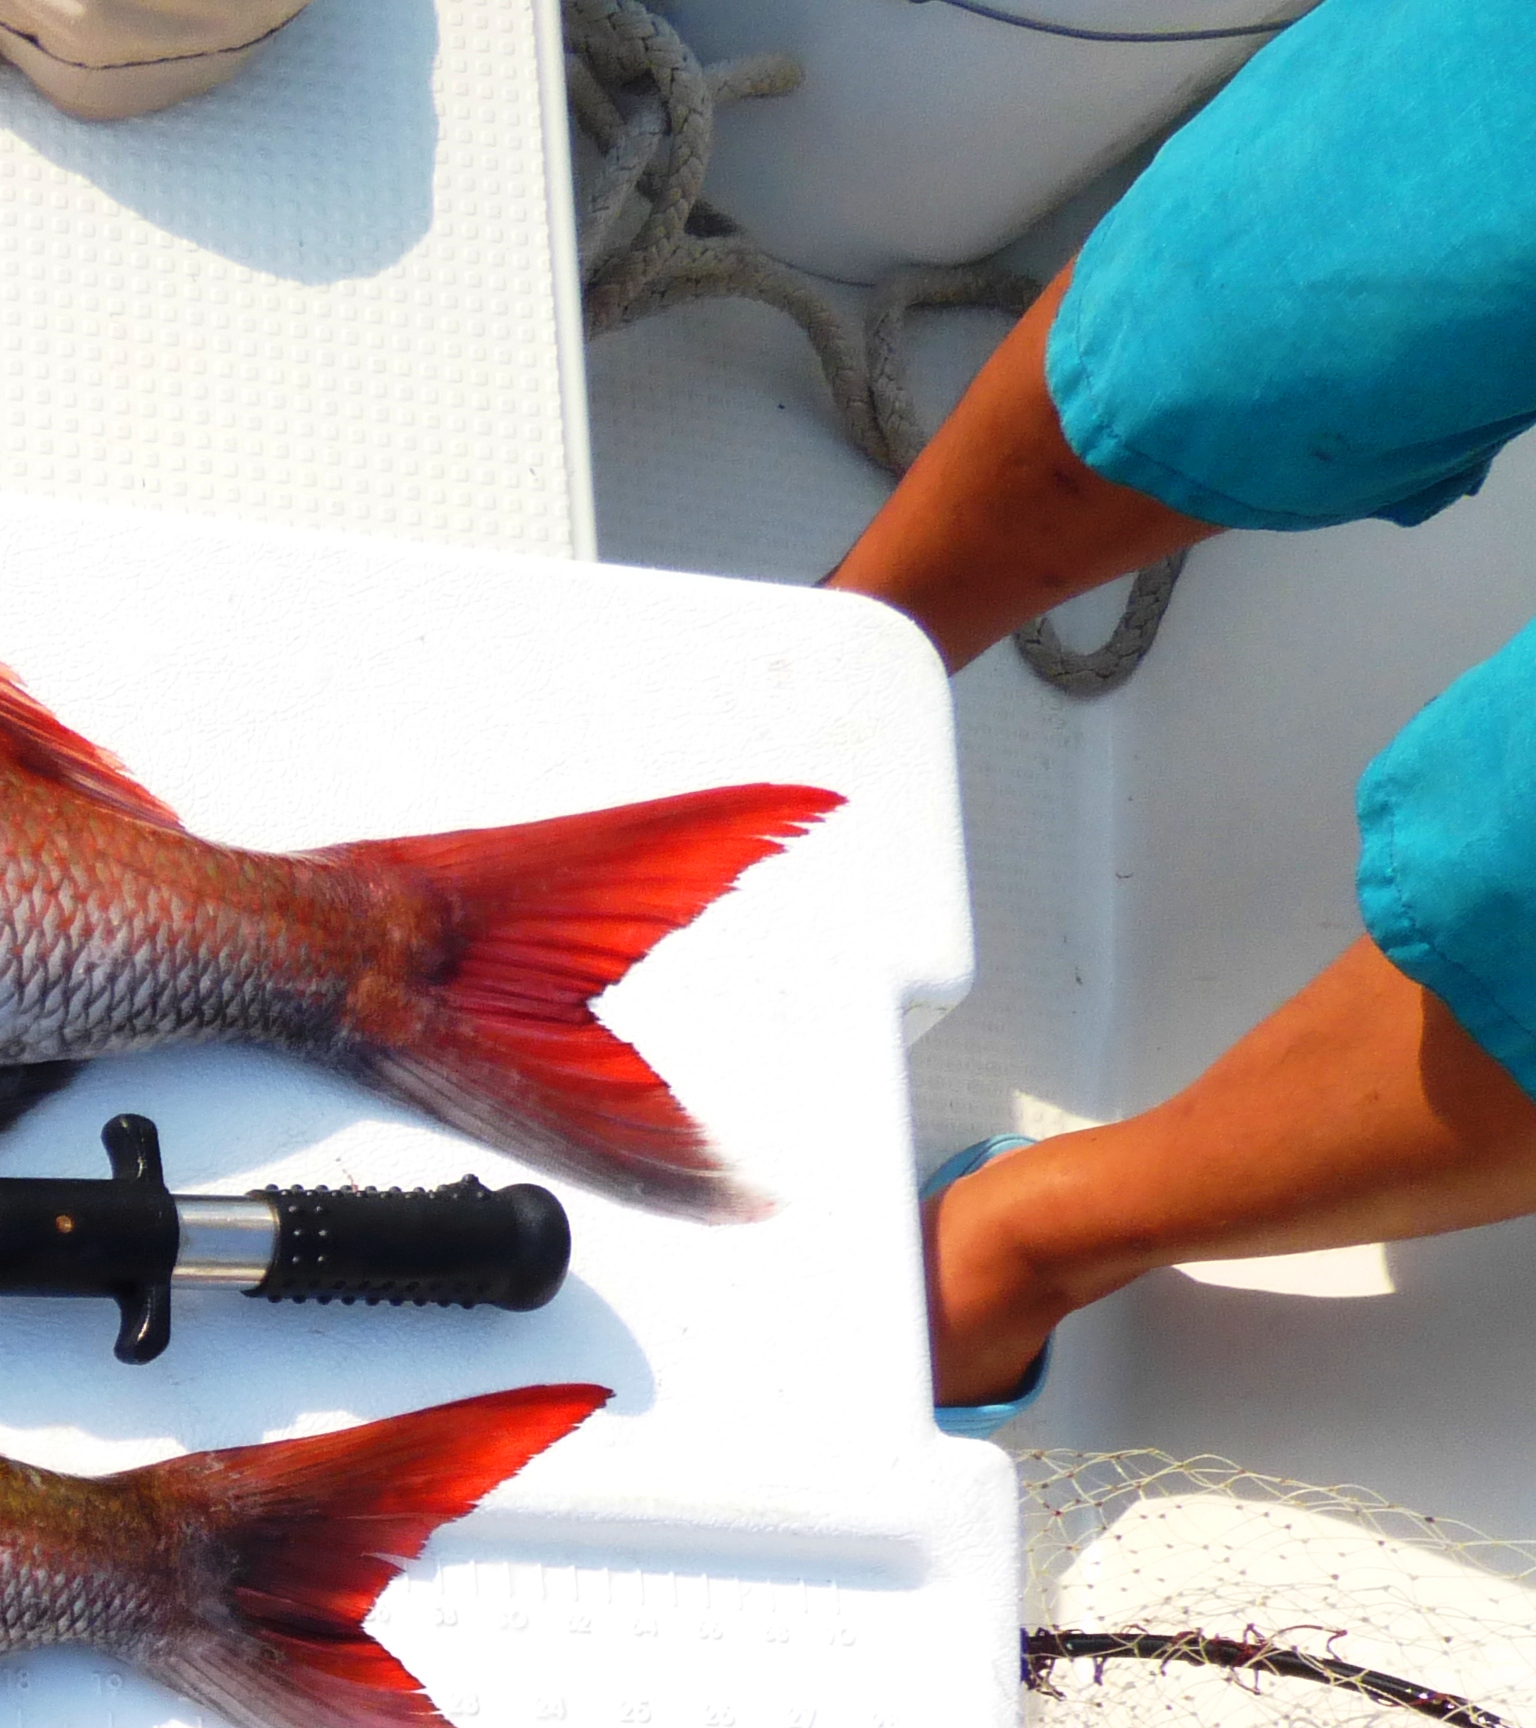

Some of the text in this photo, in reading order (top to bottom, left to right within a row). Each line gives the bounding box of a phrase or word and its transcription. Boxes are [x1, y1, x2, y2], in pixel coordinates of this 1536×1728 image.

[534, 1696, 568, 1722] 24
[618, 1700, 653, 1725] 25
[703, 1703, 737, 1728] 26
